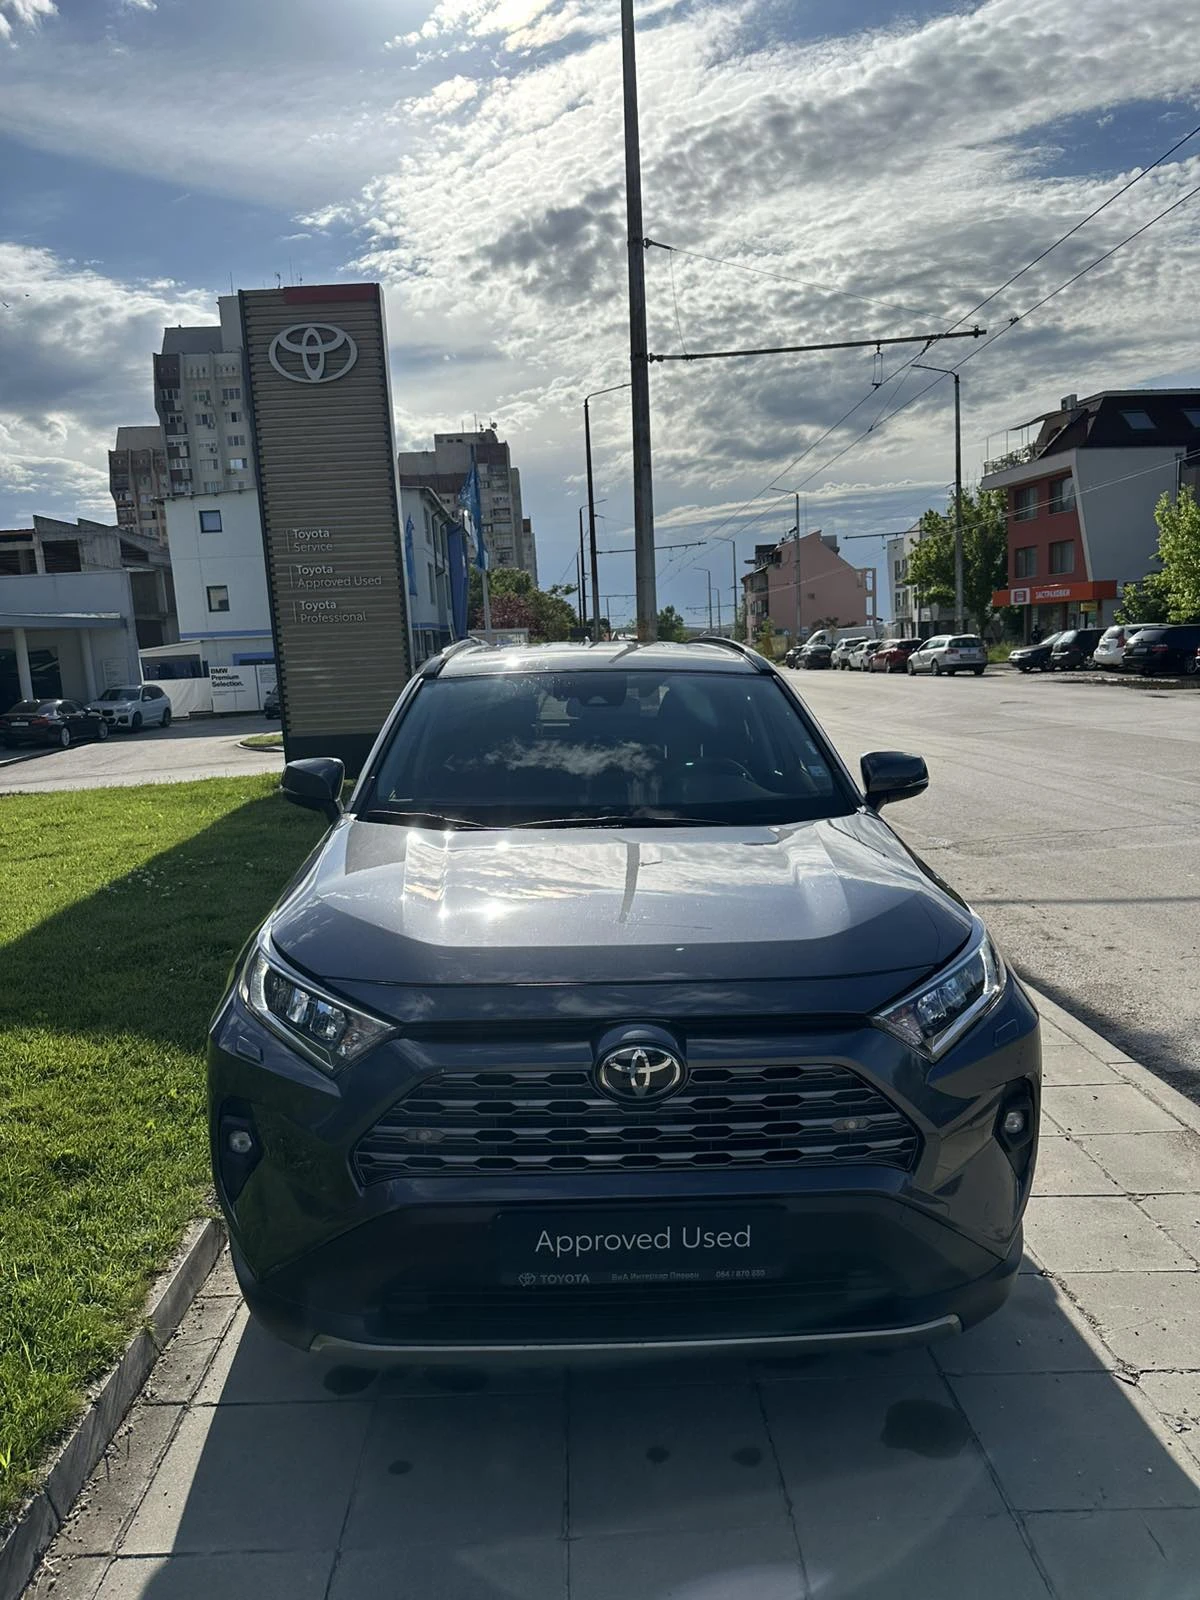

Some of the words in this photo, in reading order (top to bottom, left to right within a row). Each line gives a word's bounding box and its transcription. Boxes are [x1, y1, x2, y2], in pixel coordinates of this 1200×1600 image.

[292, 528, 330, 540] Toyota
[293, 542, 333, 552] Service
[295, 564, 334, 576] Toyota
[297, 577, 351, 592] Approved
[354, 576, 382, 586] Used
[299, 600, 337, 612] Toyota
[300, 611, 367, 623] Professional
[535, 1226, 671, 1257] Approved
[682, 1225, 751, 1249] Used
[540, 1273, 591, 1285] TOYOTA
